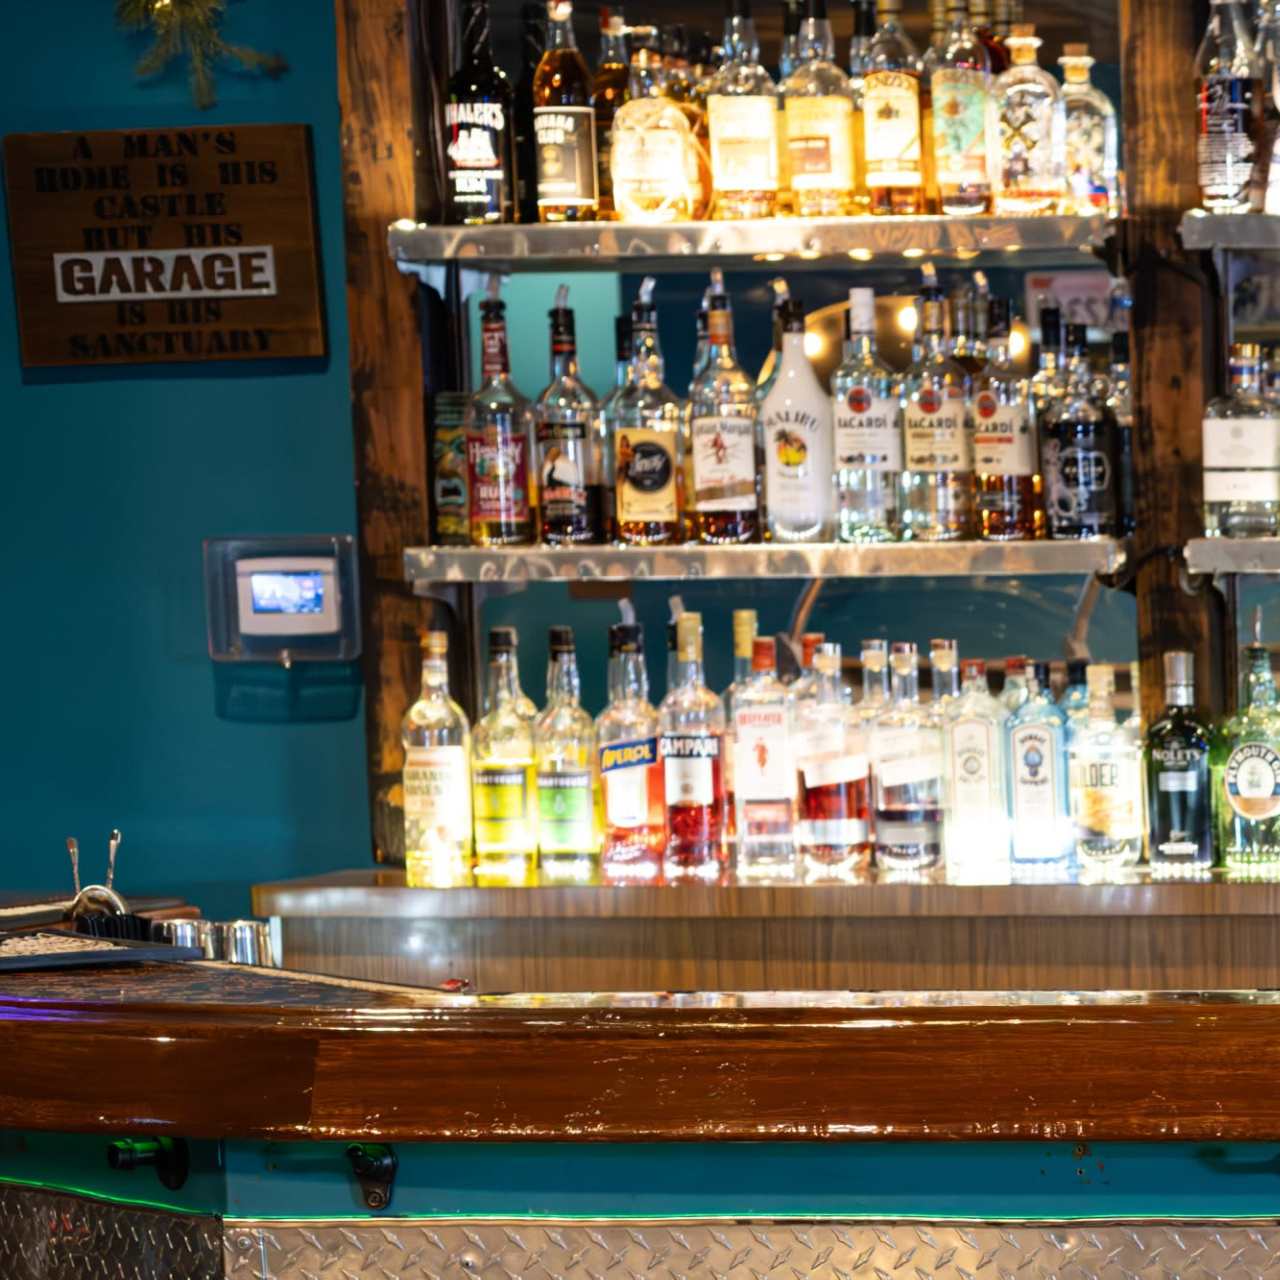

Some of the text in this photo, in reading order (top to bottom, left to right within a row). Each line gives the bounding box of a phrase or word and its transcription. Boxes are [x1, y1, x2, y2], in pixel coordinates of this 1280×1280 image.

[72, 131, 237, 160] A MAN'S
[34, 159, 279, 194] HOME IS HIS
[94, 193, 228, 220] CASTLE
[82, 224, 244, 252] BUT HIS
[60, 251, 272, 297] GARAGE
[116, 301, 222, 325] IS HIS
[68, 331, 273, 358] SANCTUARY
